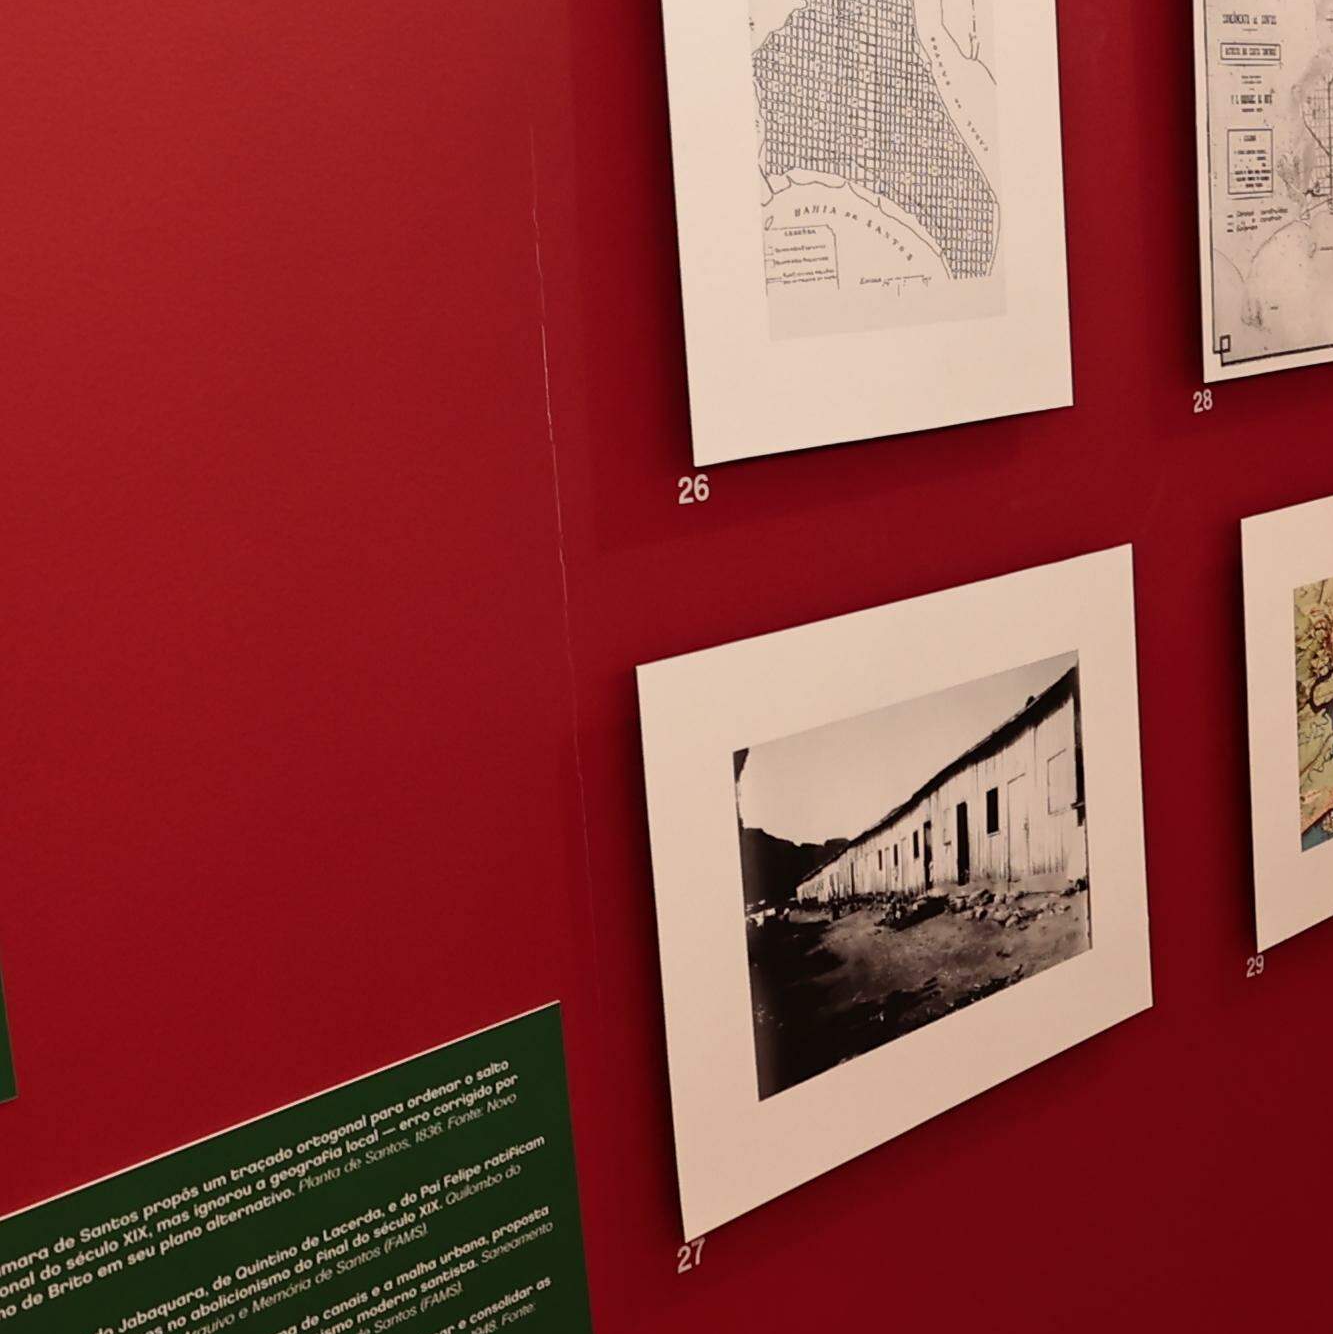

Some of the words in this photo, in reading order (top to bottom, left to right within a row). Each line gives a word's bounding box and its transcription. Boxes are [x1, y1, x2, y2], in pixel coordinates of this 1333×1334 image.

[1192, 388, 1214, 414] 28
[677, 473, 710, 505] 26
[1246, 954, 1265, 979] 29
[0, 1247, 49, 1277] mara
[53, 1236, 76, 1253] de
[79, 1211, 139, 1243] Santos
[203, 1175, 227, 1193] um
[230, 1147, 293, 1181] traçado
[296, 1114, 367, 1154] ortogonal
[370, 1102, 404, 1128] para
[407, 1079, 462, 1109] ordenar
[464, 1075, 474, 1085] o
[476, 1060, 509, 1081] salto
[212, 1275, 232, 1291] de
[235, 1246, 298, 1280] Quintino
[301, 1236, 320, 1251] de
[388, 1202, 398, 1213] e
[400, 1192, 418, 1207] do
[420, 1179, 441, 1199] Pai
[443, 1164, 482, 1189] Felipe
[484, 1136, 545, 1170] ratificam
[301, 1315, 320, 1331] de
[322, 1291, 369, 1320] canais
[371, 1286, 380, 1297] e
[383, 1280, 393, 1291] a
[396, 1259, 437, 1286] malha
[492, 1205, 549, 1244] proposta
[676, 1236, 707, 1275] 27
[457, 1319, 467, 1330] e
[469, 1285, 534, 1324] consolidar
[536, 1276, 552, 1291] as
